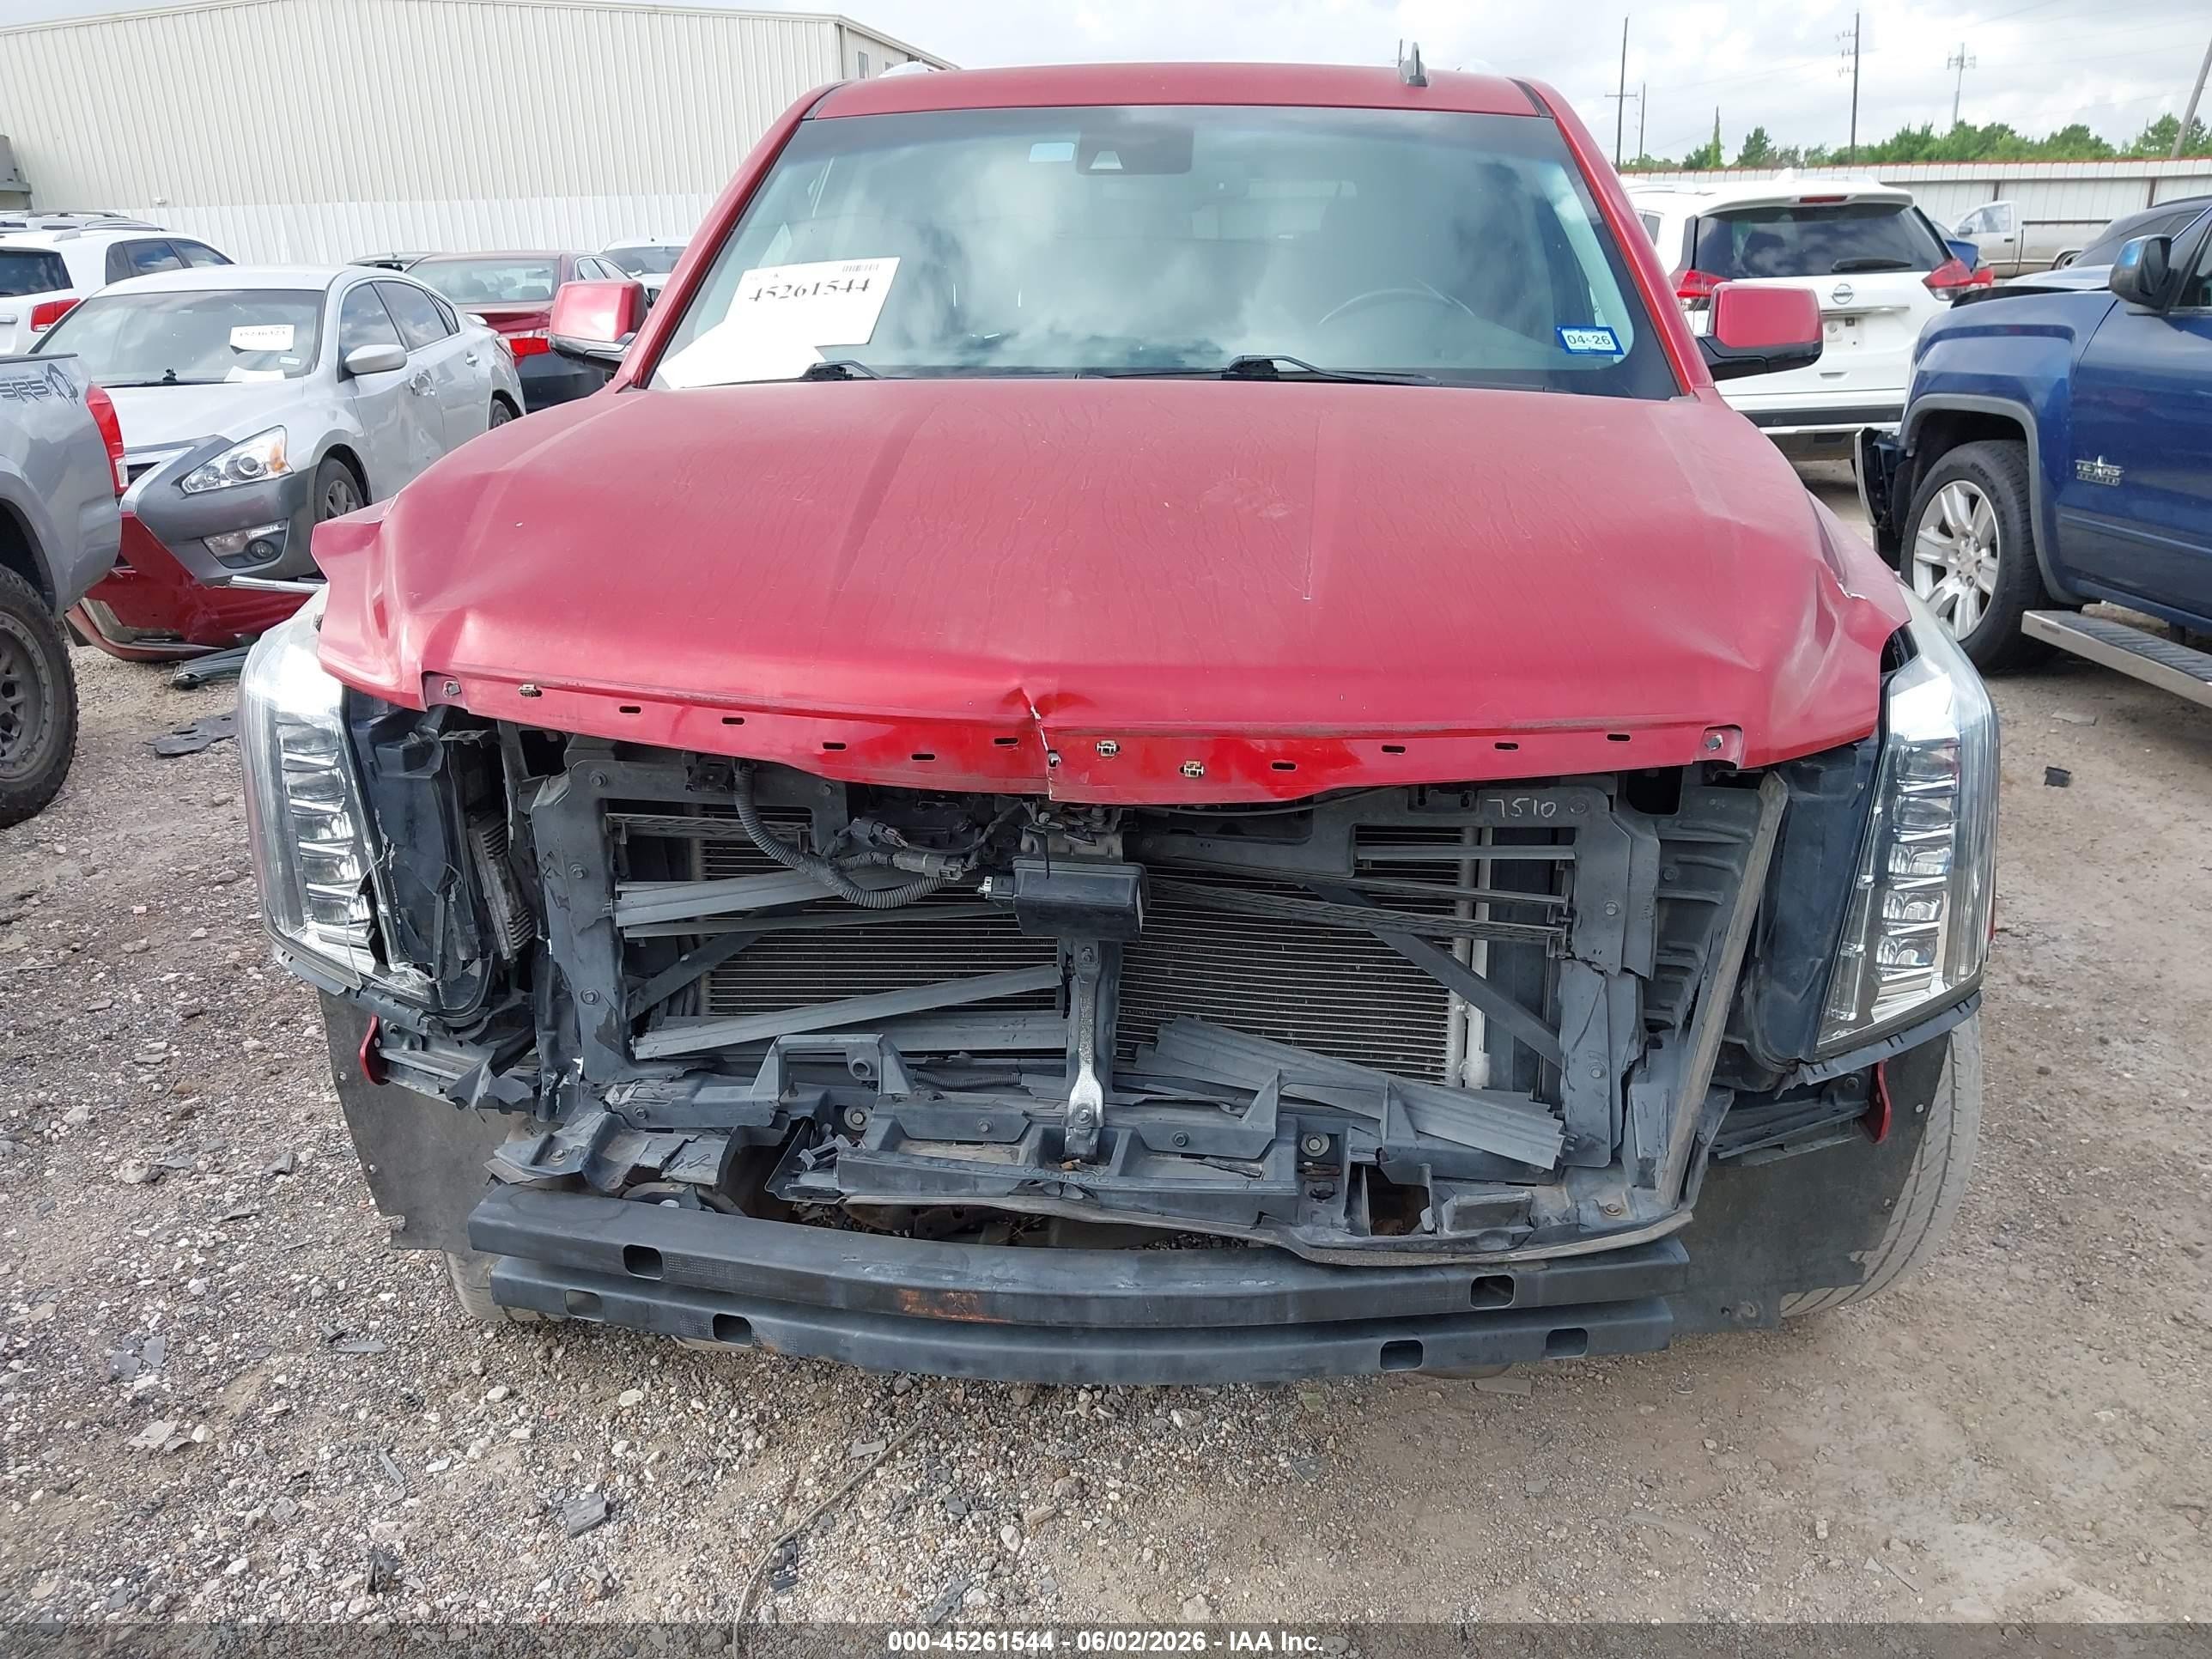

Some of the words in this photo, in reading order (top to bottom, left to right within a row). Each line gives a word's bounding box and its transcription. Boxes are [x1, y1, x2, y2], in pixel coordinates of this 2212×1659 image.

[749, 278, 870, 301] 45261544
[1486, 797, 1557, 818] 7510
[1023, 1167, 1111, 1184] CADILLAC
